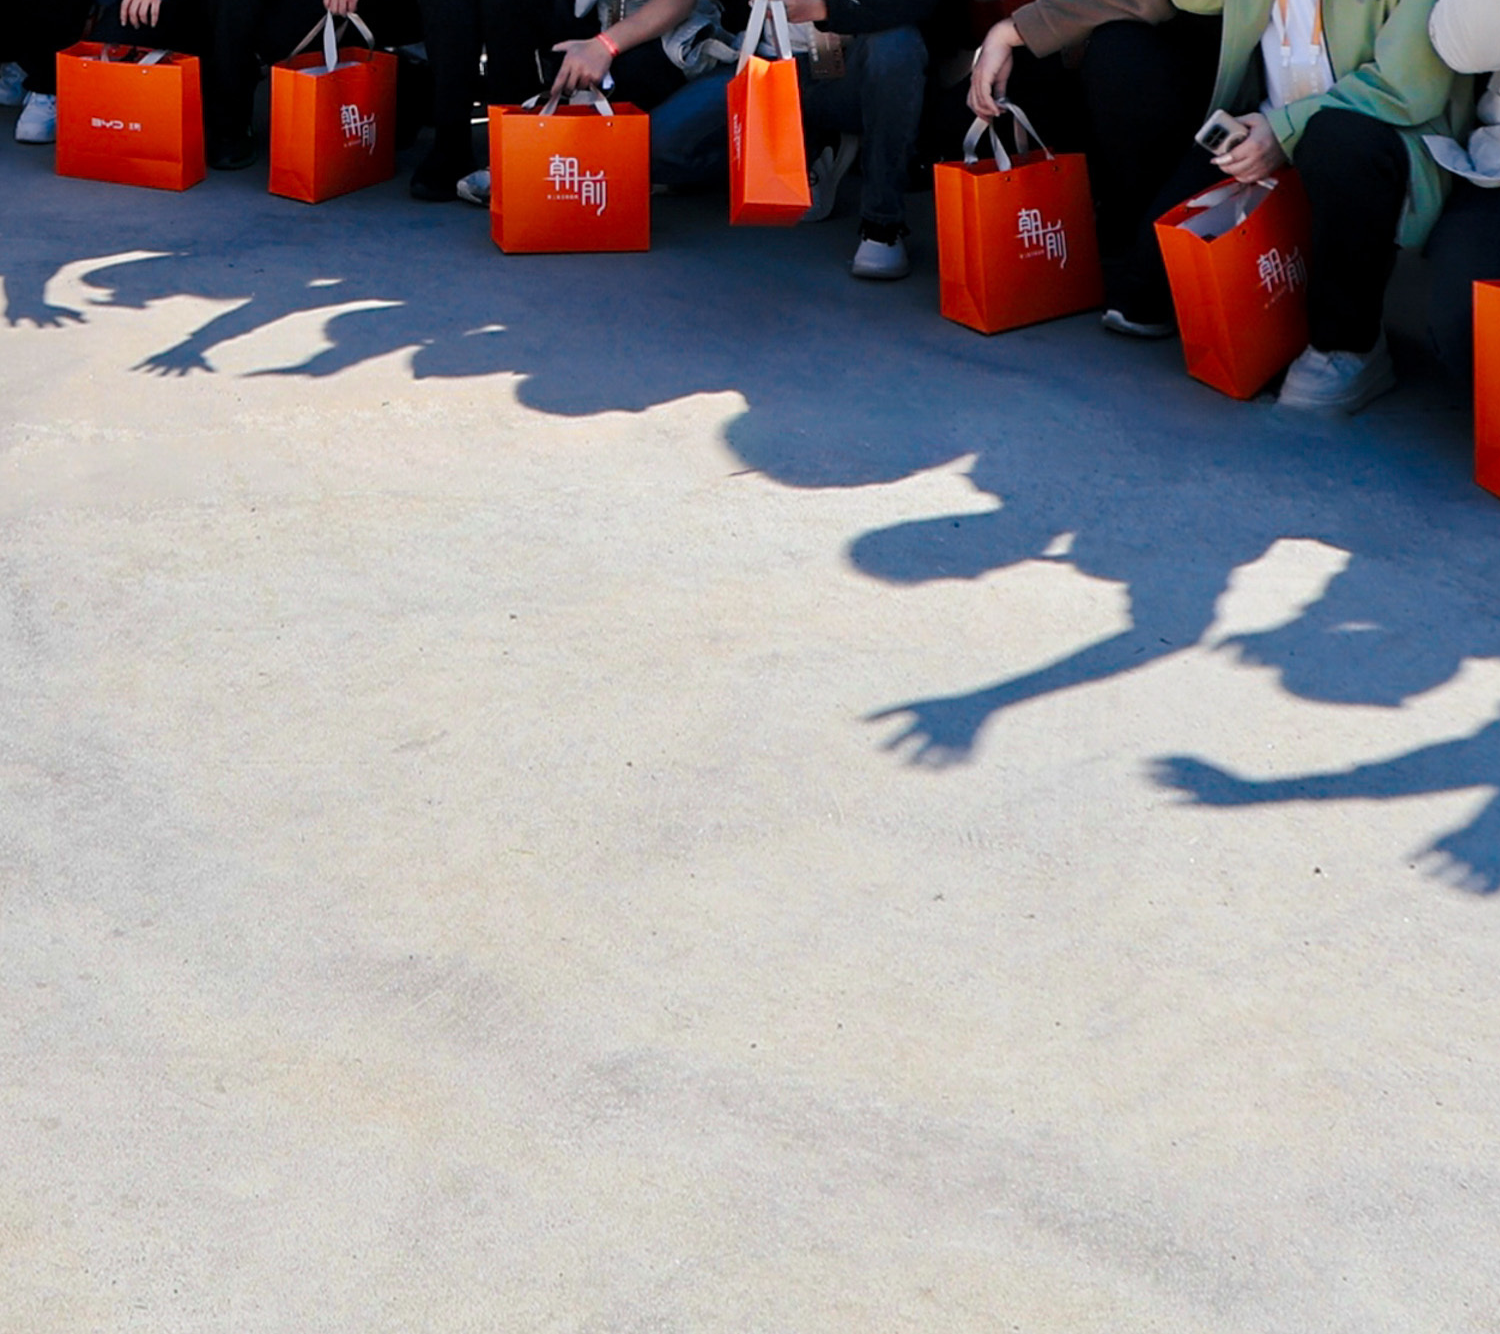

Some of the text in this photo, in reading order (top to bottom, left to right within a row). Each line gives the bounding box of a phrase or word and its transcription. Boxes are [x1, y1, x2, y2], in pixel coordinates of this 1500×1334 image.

[91, 117, 124, 130] BYD
[545, 154, 608, 217] 朝前
[1016, 208, 1068, 269] 朝前
